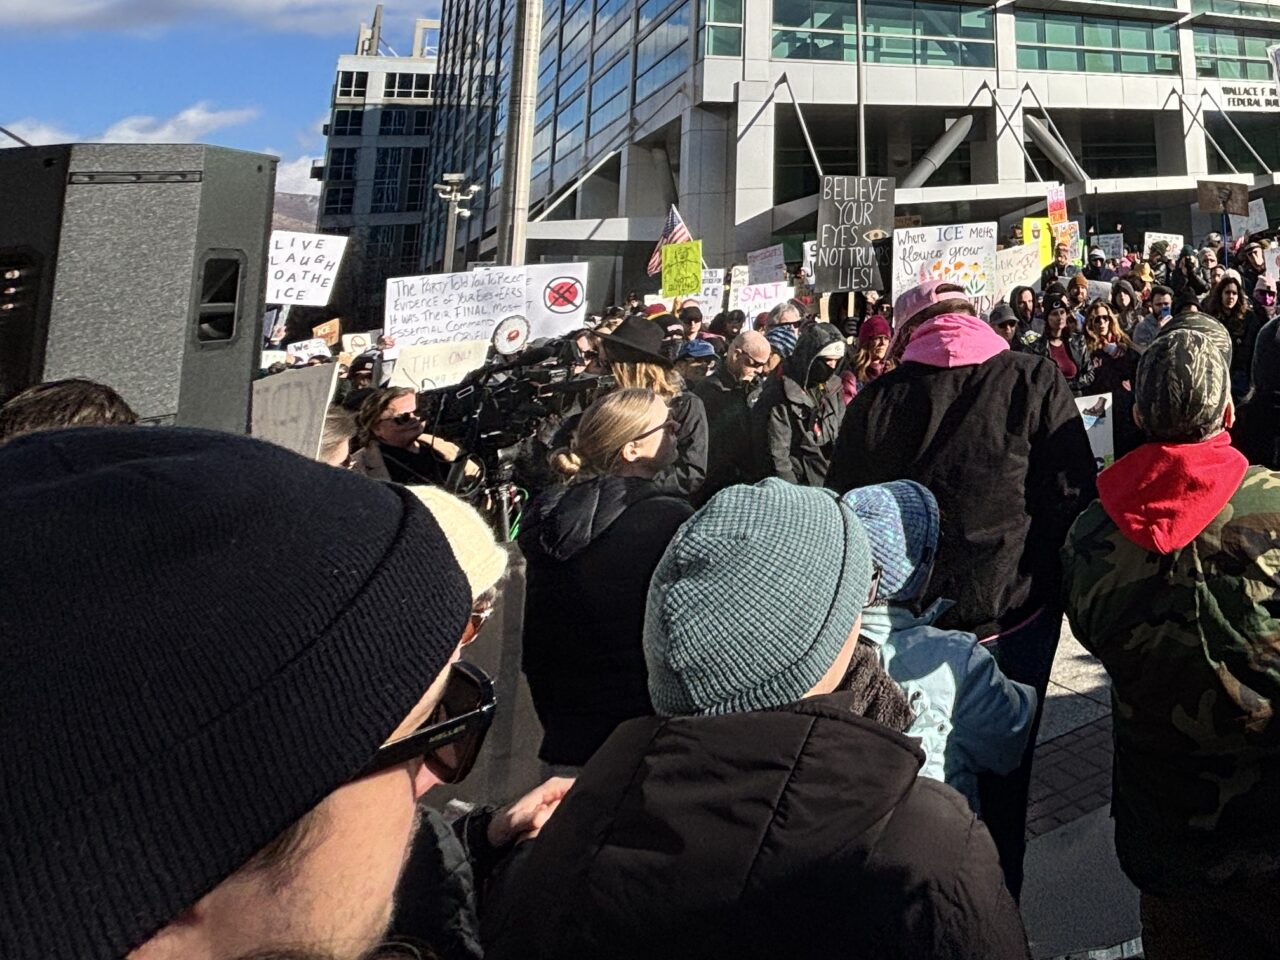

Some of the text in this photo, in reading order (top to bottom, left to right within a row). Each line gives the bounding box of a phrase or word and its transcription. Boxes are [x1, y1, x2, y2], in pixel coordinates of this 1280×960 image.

[1221, 86, 1258, 96] WALLACE
[1227, 97, 1262, 107] FEDERAL
[823, 176, 889, 202] BELIEVE
[835, 201, 874, 225] YOUR
[275, 237, 325, 250] LIVE
[822, 224, 858, 248] EYES
[897, 230, 927, 246] Where
[936, 225, 964, 242] ICE
[270, 253, 336, 271] LAUGH
[818, 246, 844, 267] NOT
[949, 245, 983, 265] grow
[838, 266, 873, 290] LIES!
[275, 287, 306, 300] ICE
[392, 280, 417, 298] The
[741, 283, 780, 301] SALT
